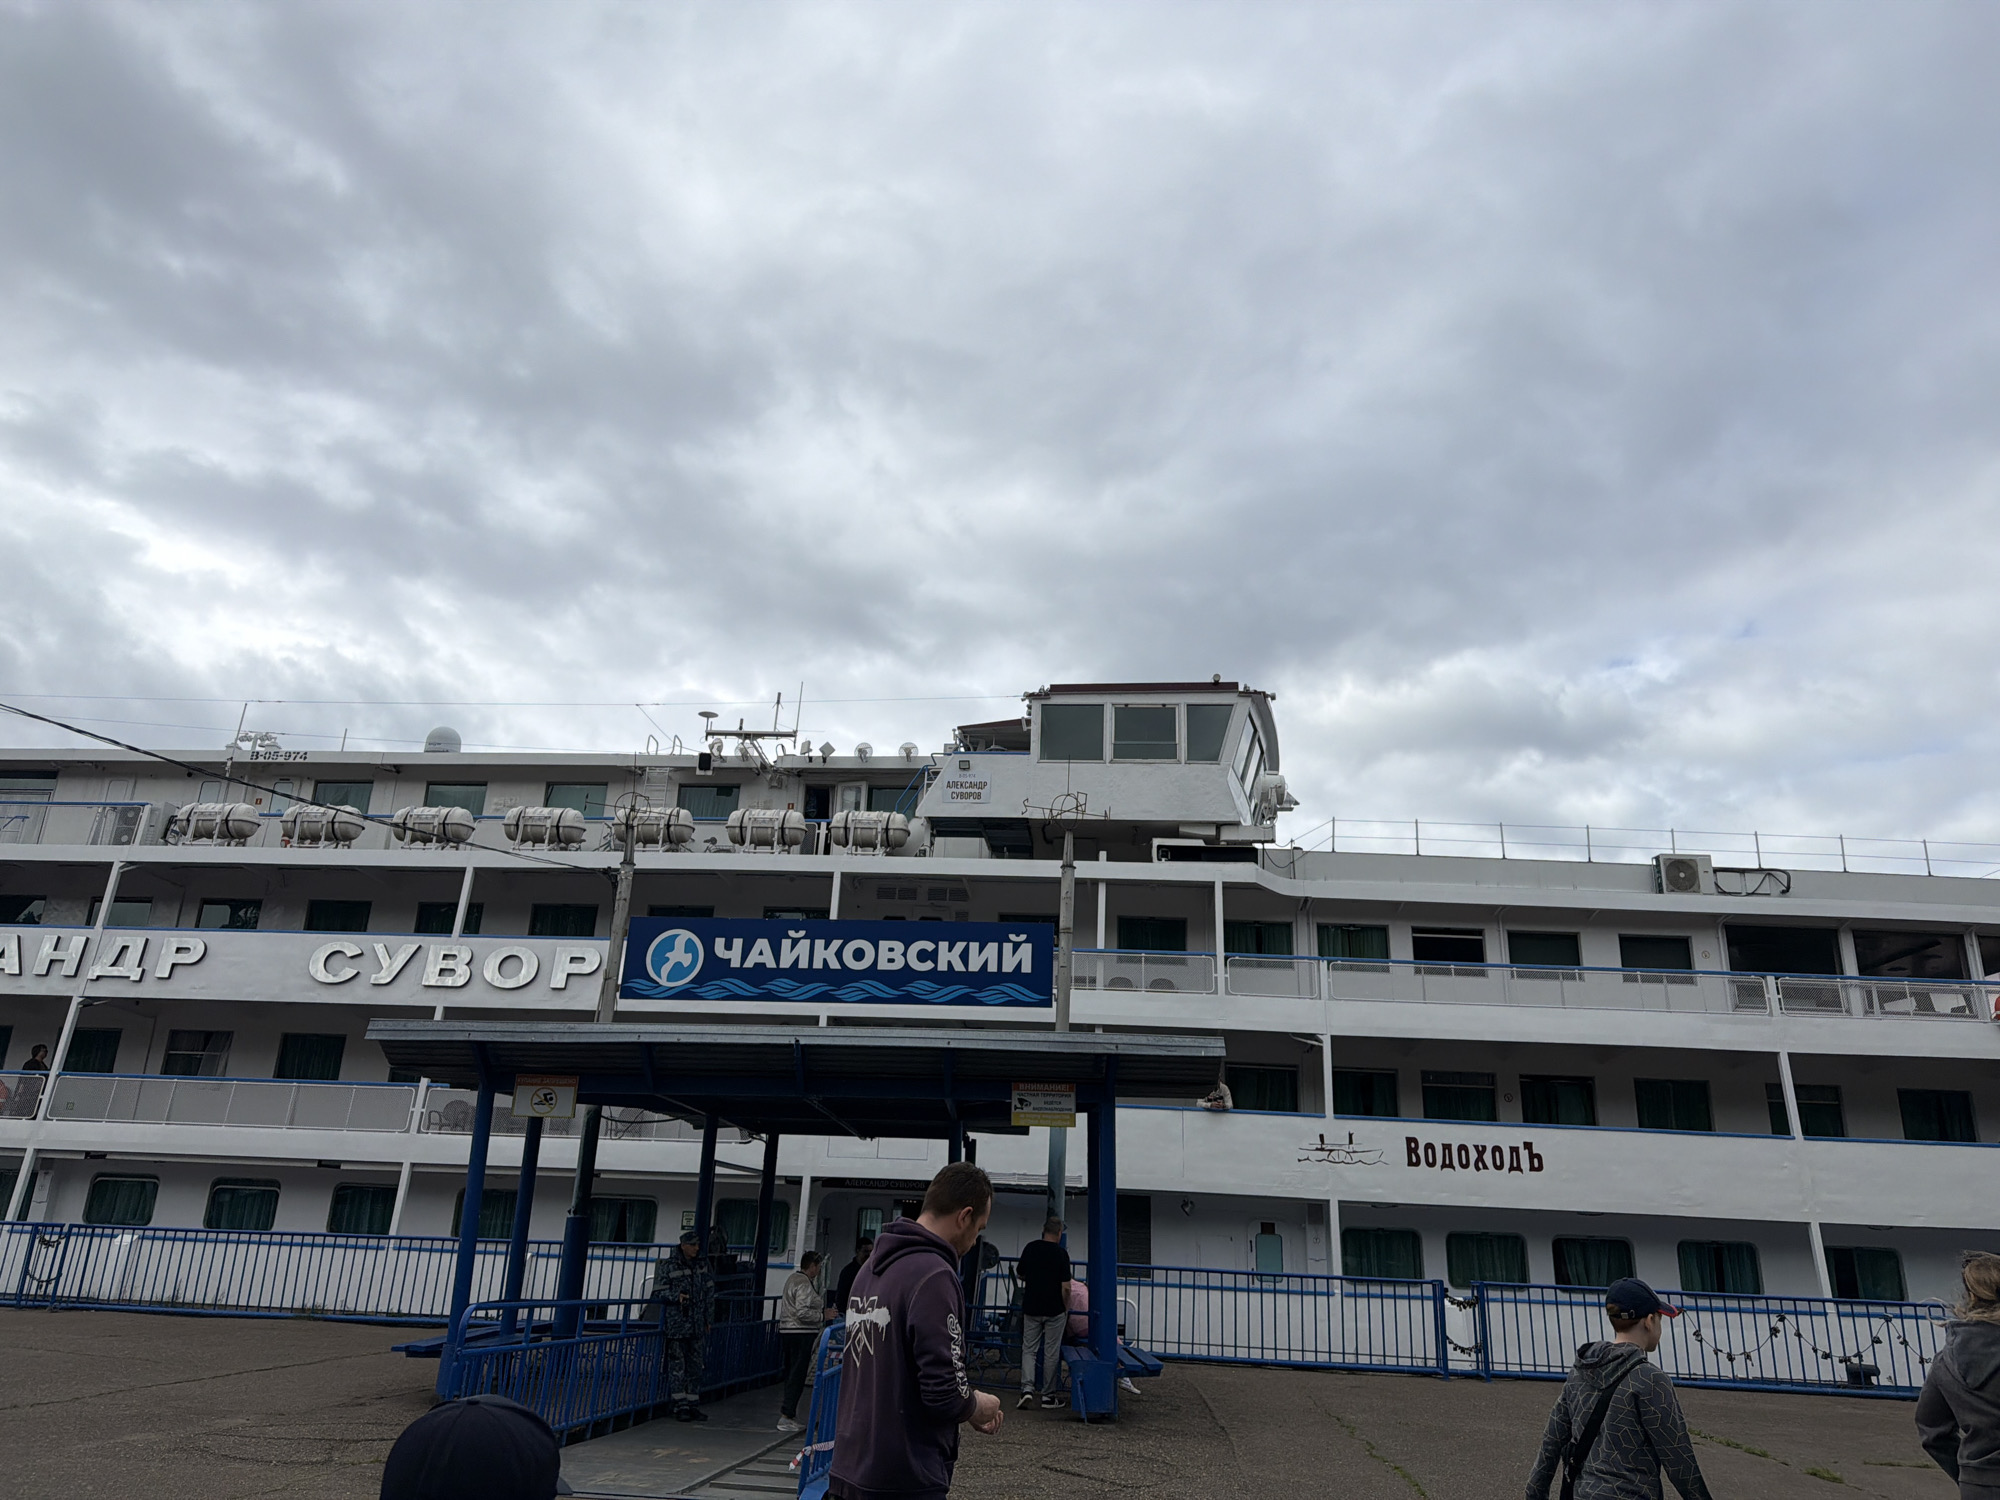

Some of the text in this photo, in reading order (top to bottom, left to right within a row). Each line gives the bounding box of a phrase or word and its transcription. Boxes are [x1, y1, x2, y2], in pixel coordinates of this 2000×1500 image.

[250, 751, 308, 761] В-05-974
[946, 780, 988, 790] АЛЕКСАНДР
[951, 791, 982, 800] СУВОРОВ
[714, 929, 1033, 974] ЧАЙКОВСКИЙ
[308, 941, 601, 989] СУВОР
[1019, 1083, 1069, 1092] ВНИМАНИЕ!
[845, 1179, 925, 1189] АЛЕКСАНДР СУВОРОВ
